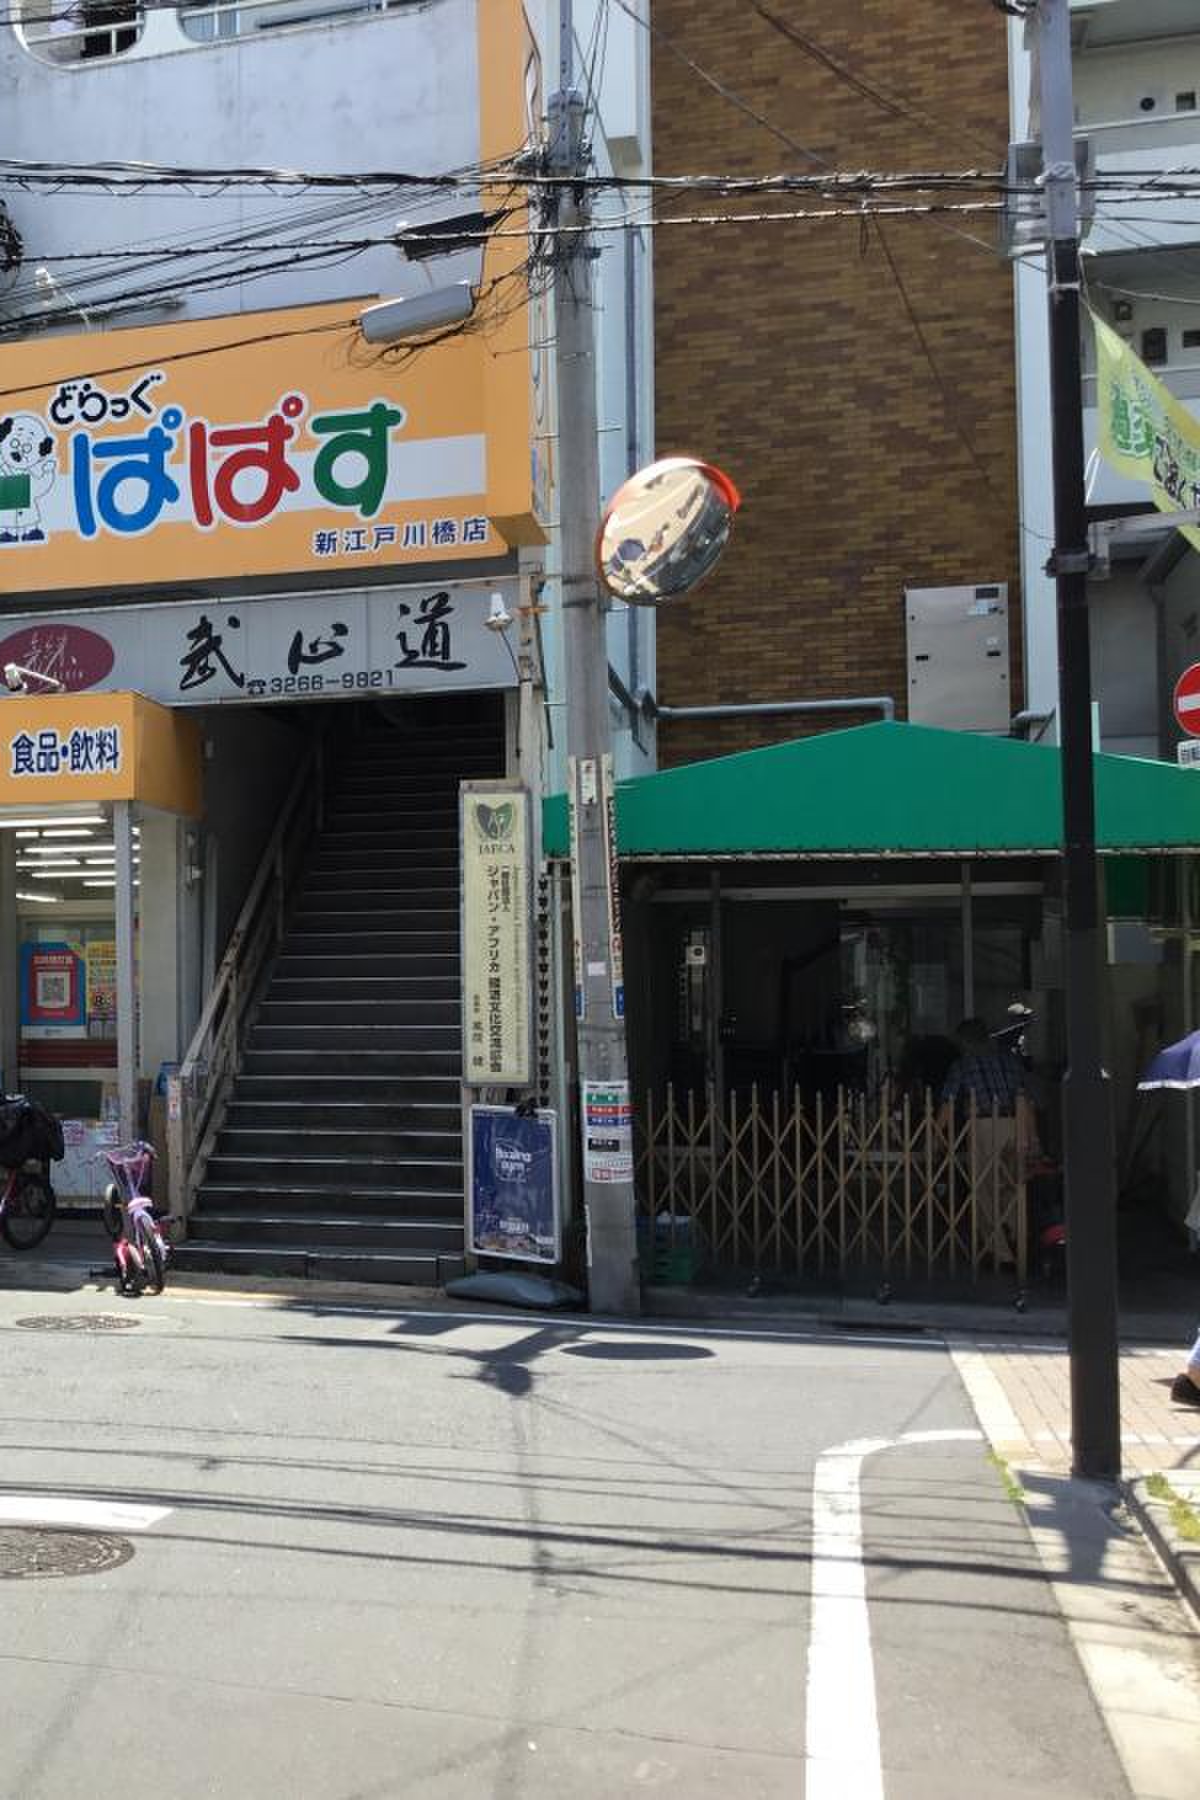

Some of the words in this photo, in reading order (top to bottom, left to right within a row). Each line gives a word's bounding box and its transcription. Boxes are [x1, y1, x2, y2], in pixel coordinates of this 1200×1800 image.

[50, 374, 163, 426] どらっぐ
[73, 395, 401, 534] ぱぱす
[314, 518, 488, 555] 新江戸川橋店
[178, 591, 467, 692] 武心道
